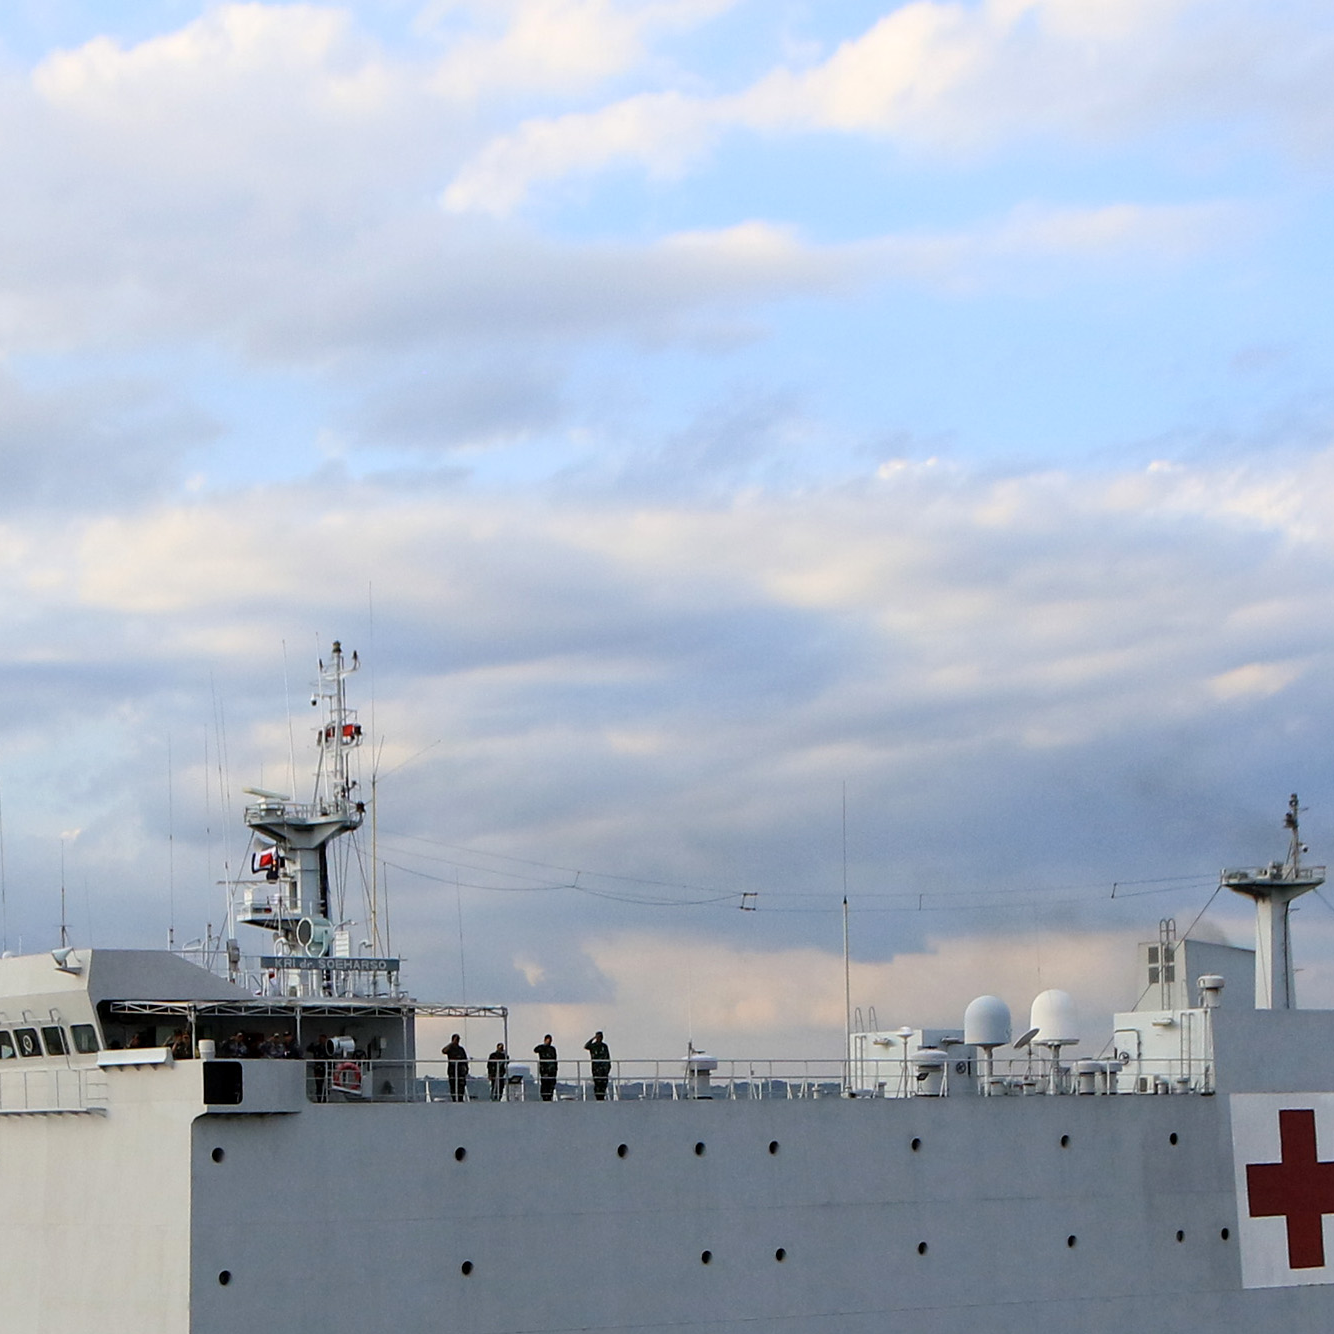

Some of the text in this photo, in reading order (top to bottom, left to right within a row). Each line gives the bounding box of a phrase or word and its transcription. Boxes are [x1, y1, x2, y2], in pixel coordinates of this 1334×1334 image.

[274, 958, 387, 970] KRI dr. SOEHARSO
